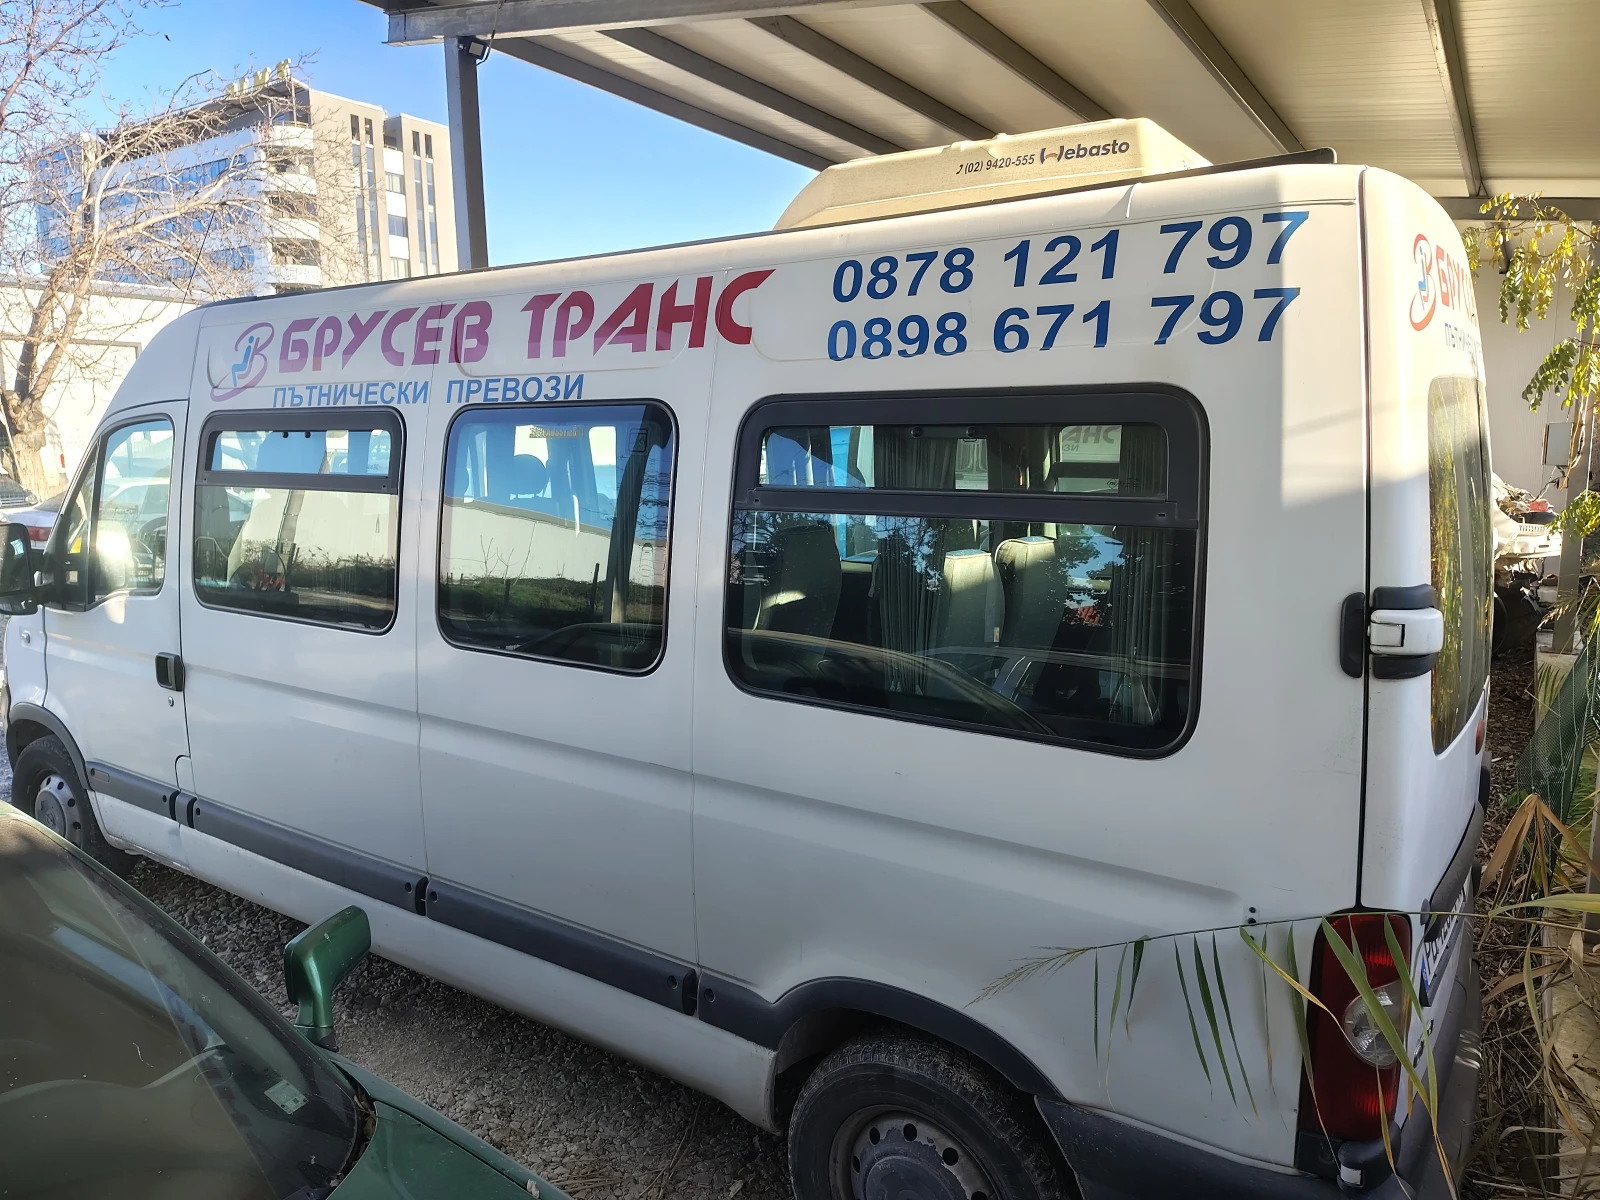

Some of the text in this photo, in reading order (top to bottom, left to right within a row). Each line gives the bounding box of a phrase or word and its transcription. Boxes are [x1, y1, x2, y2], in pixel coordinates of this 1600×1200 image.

[964, 140, 1129, 175] (02) 9420-555 Webasto
[833, 210, 1310, 302] 0878 121 797
[279, 302, 492, 372] БРУСЕВ
[521, 269, 775, 357] ТРАНС
[827, 287, 1302, 361] 0898 671 797
[272, 374, 584, 408] ПЪТНИЧЕСКИ ПРЕВОЗИ
